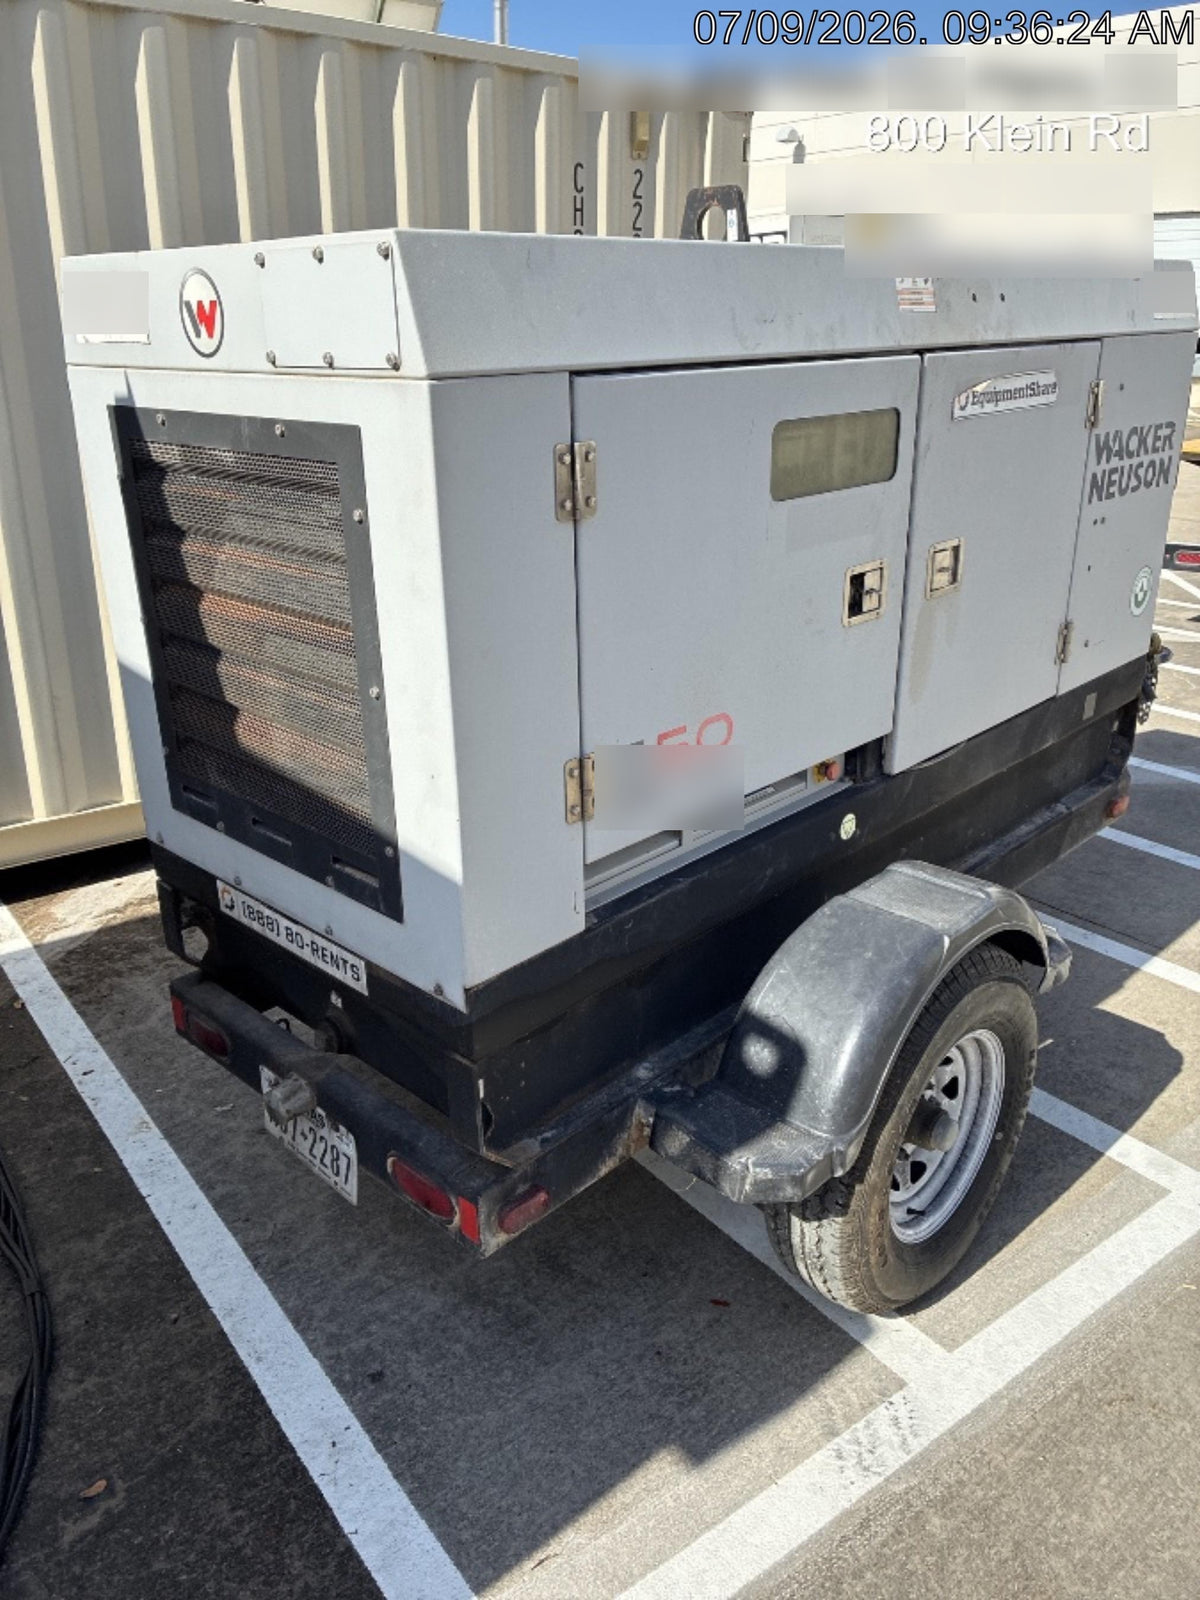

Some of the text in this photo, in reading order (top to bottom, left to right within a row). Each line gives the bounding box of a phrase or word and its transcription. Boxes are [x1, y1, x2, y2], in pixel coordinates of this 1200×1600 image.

[573, 162, 584, 236] CH
[632, 168, 644, 238] 22
[970, 380, 1058, 409] EquipmentShare
[1094, 420, 1177, 467] WACKER
[1087, 456, 1173, 505] NEUSON
[241, 900, 361, 983] (888) 80-RENTS
